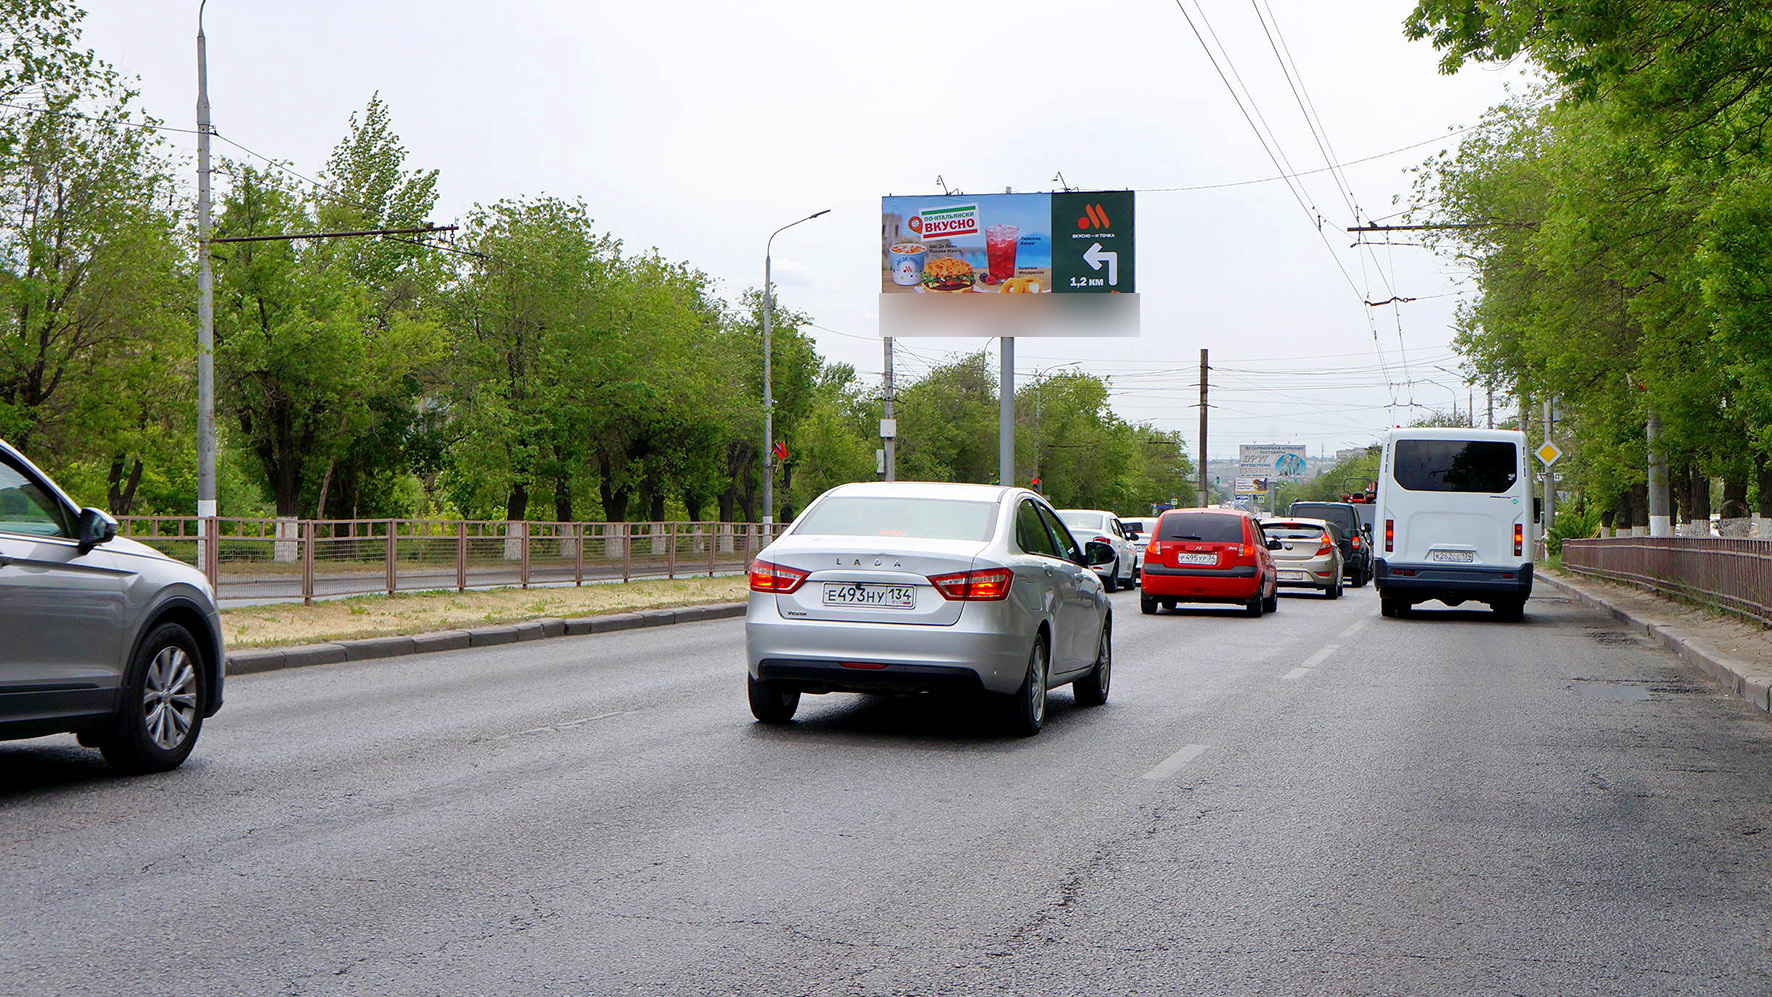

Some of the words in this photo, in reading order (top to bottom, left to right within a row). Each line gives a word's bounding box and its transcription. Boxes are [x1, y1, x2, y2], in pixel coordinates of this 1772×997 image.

[924, 211, 975, 222] ПО-ИТАЛЬЯНСКИ
[925, 218, 975, 233] ВКУСНО
[1069, 276, 1087, 288] 1,2
[836, 558, 901, 567] LADA
[888, 588, 912, 601] 134
